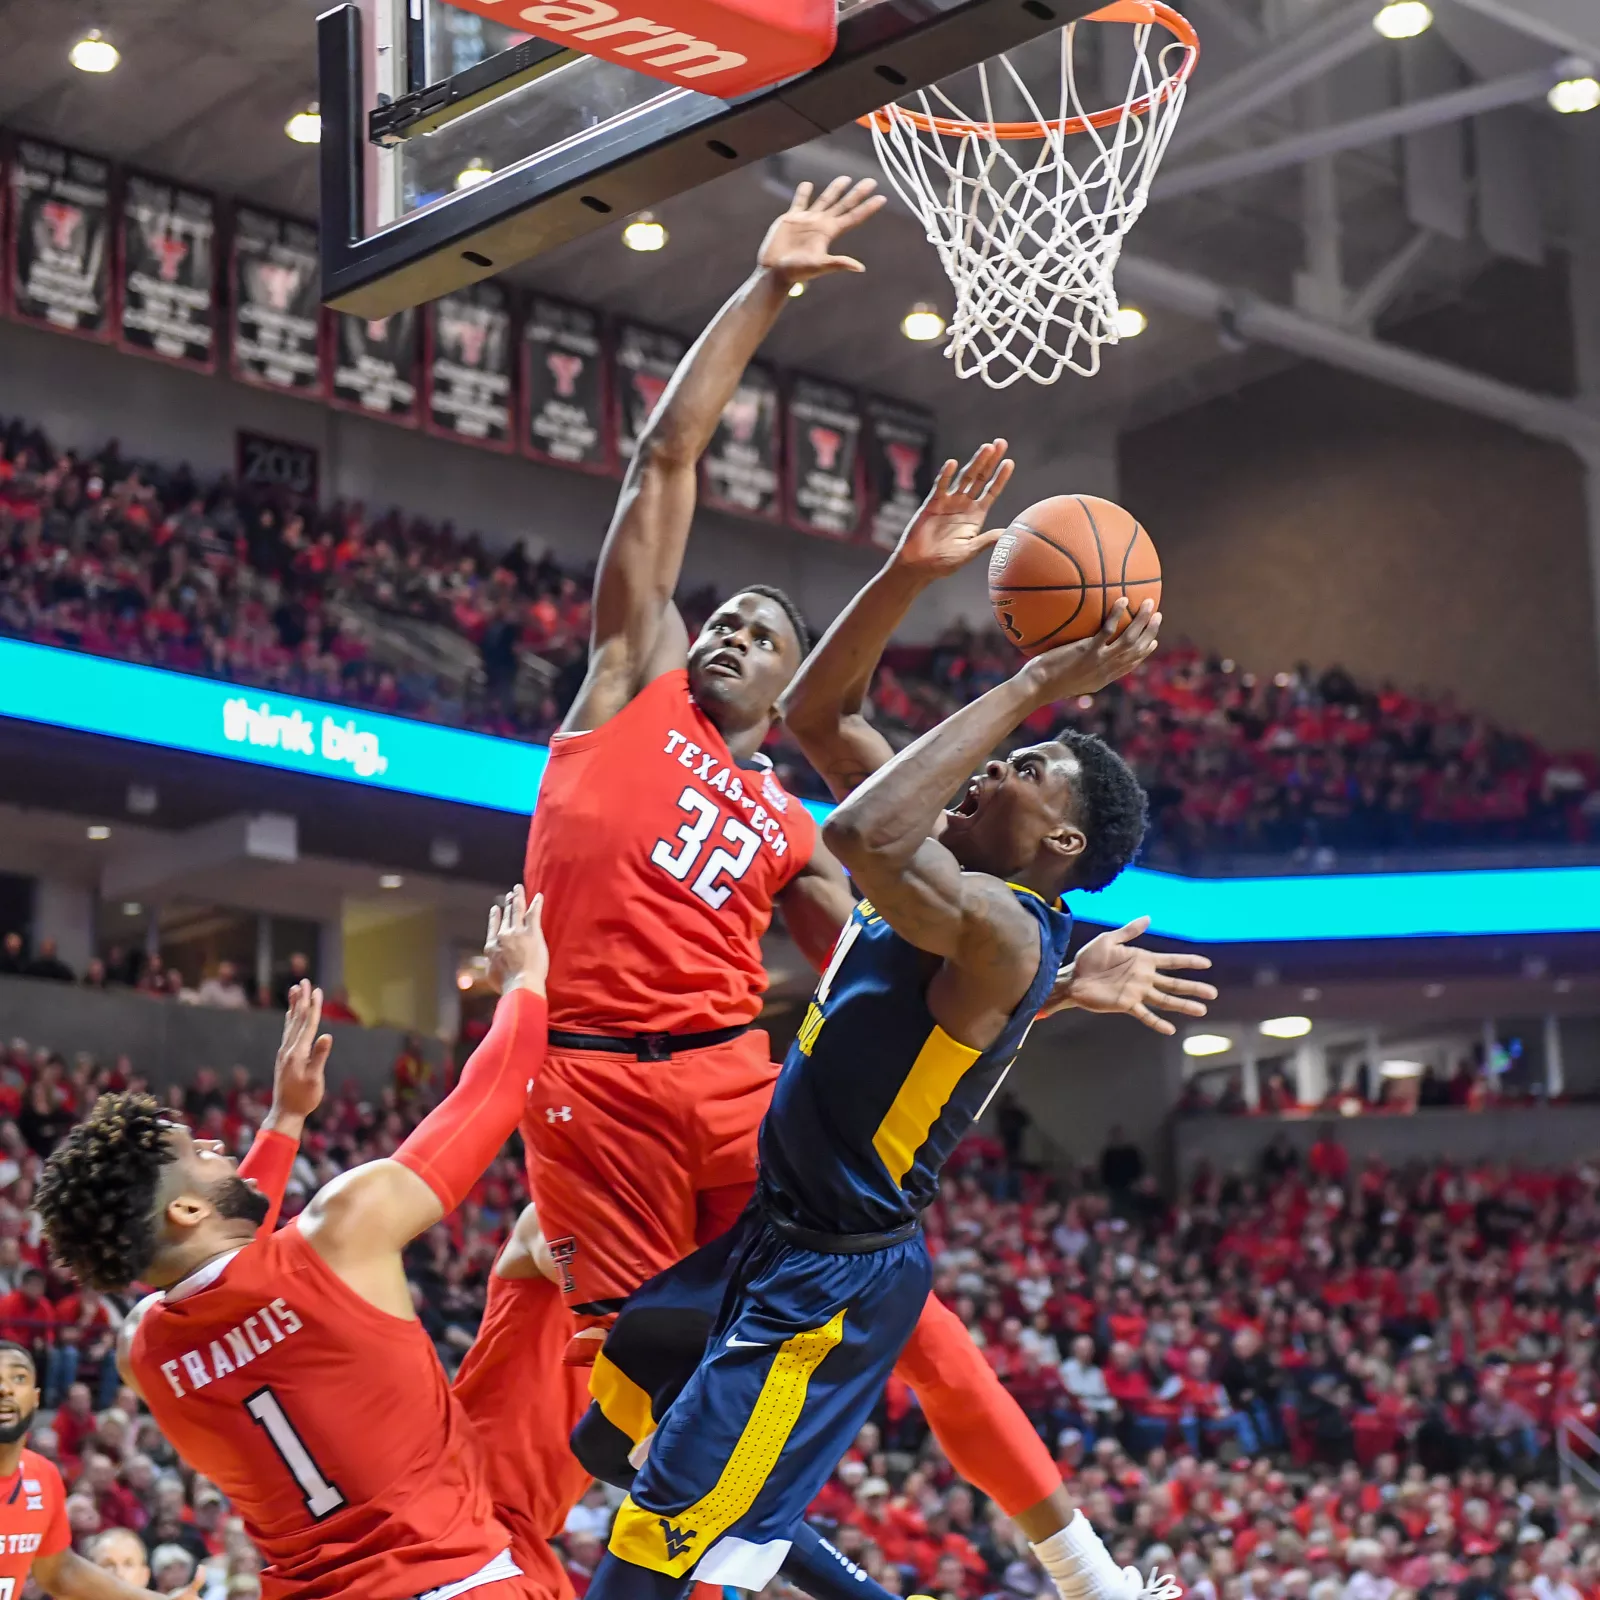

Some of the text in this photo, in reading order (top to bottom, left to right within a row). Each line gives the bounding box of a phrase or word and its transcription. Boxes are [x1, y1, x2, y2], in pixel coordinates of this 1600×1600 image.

[478, 0, 747, 78] arm
[223, 698, 388, 776] think big.
[664, 729, 744, 801] TEXAS
[651, 785, 762, 910] 32
[160, 1298, 304, 1398] FRANCIS
[243, 1385, 346, 1521] 1
